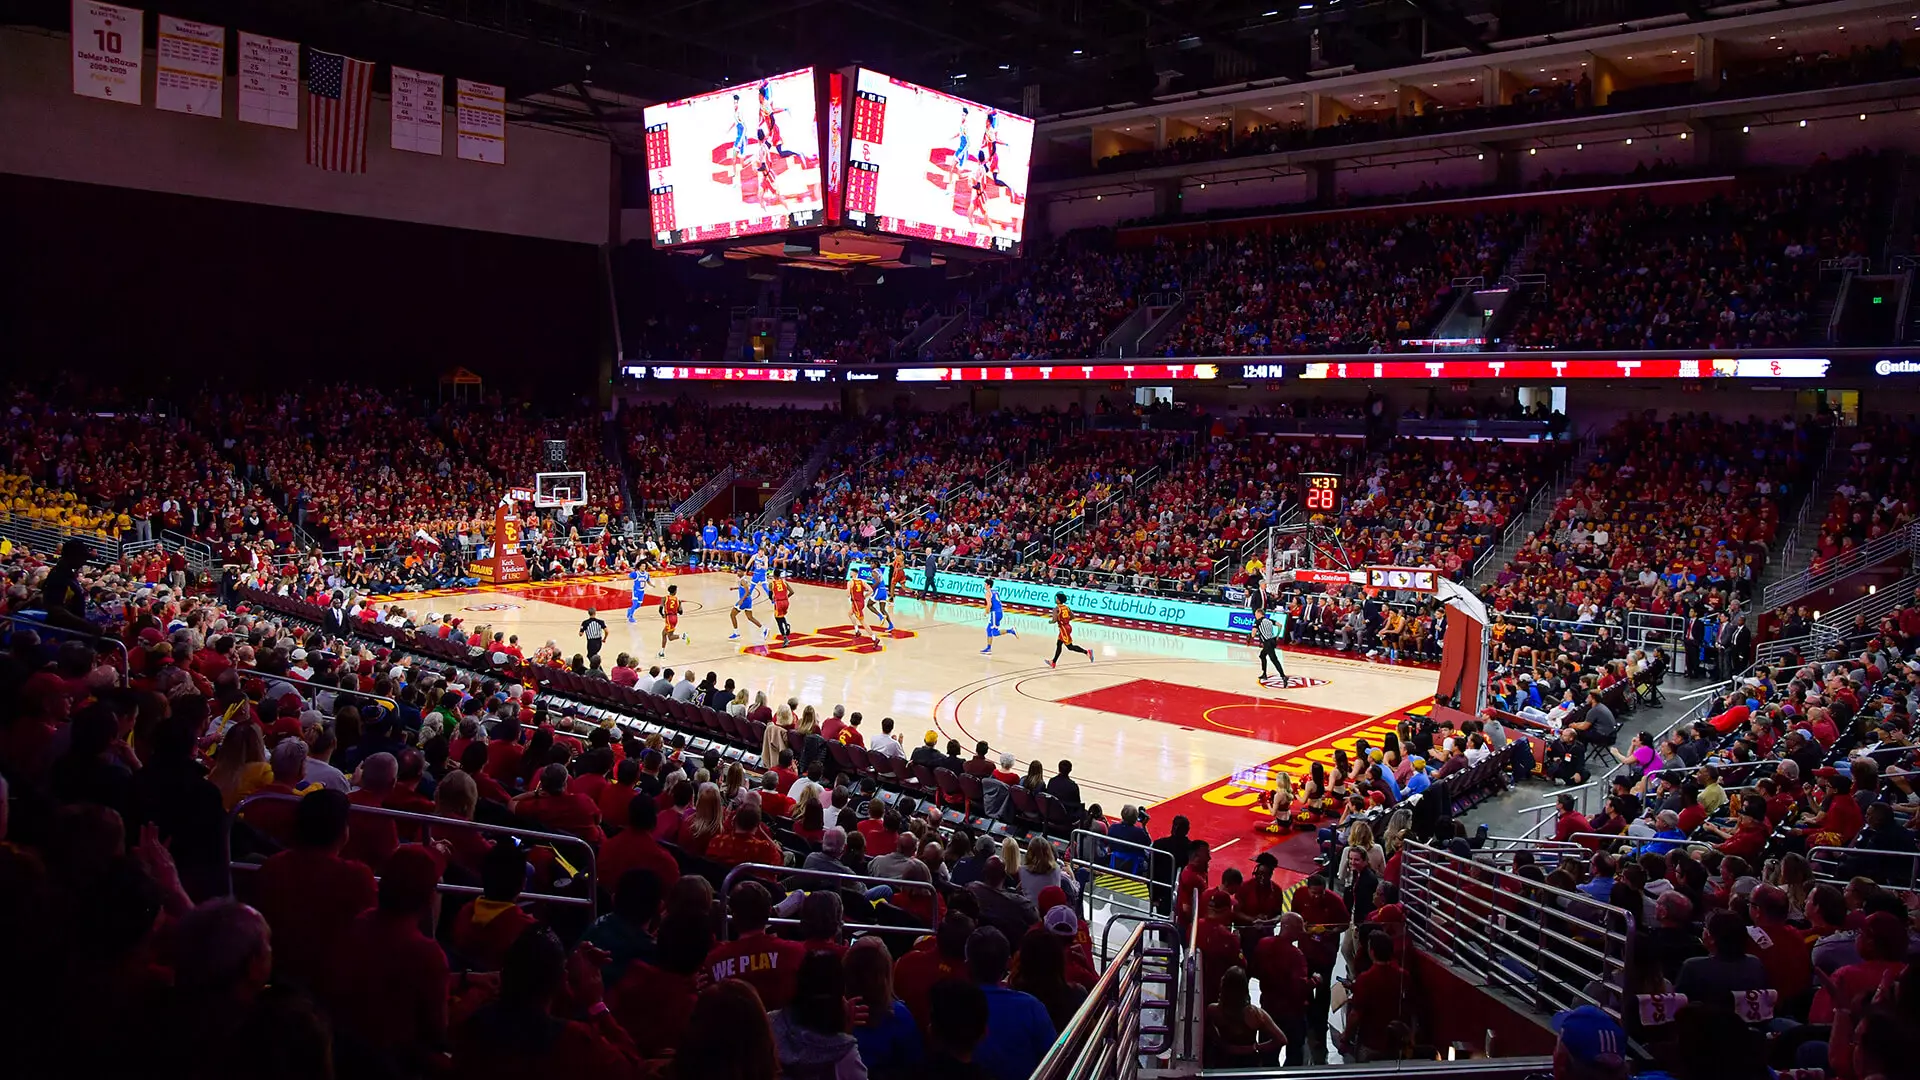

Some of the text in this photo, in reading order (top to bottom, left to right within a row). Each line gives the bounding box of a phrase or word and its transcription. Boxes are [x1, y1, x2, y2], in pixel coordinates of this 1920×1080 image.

[93, 29, 122, 54] 10
[78, 51, 138, 68] DeMar DeRozan
[1771, 361, 1782, 376] SC
[1312, 478, 1338, 488] 4:37
[1307, 489, 1333, 509] 28
[505, 522, 517, 541] SC
[469, 564, 494, 575] TROJANS
[670, 600, 676, 609] 2
[912, 572, 945, 589] Ticets
[1079, 593, 1098, 609] the
[1101, 595, 1157, 616] StubHub
[1159, 606, 1186, 622] app
[1232, 615, 1256, 626] StubH
[712, 952, 779, 982] WE PLAY
